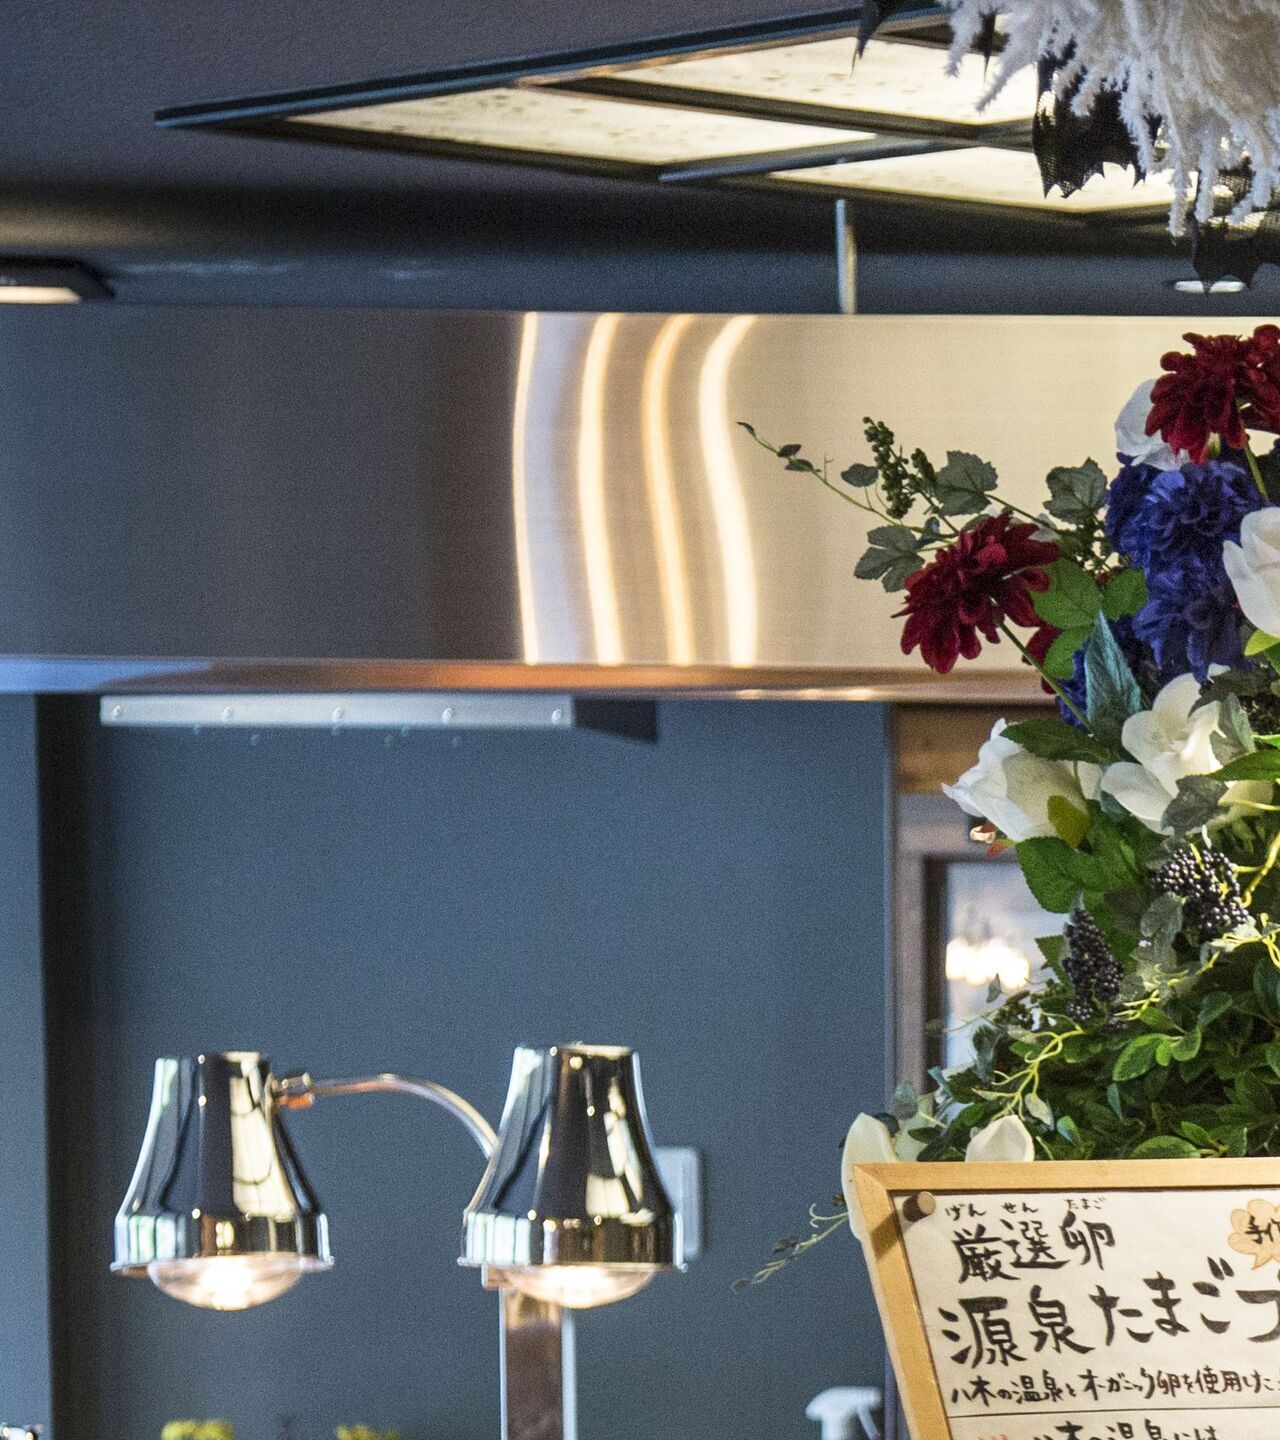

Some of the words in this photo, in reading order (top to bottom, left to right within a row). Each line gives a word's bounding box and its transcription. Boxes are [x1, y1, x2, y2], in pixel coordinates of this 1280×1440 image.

[944, 1202, 987, 1221] げん
[1001, 1202, 1039, 1214] せん
[1063, 1196, 1107, 1210] たまご
[950, 1210, 1116, 1284] 厳選卵
